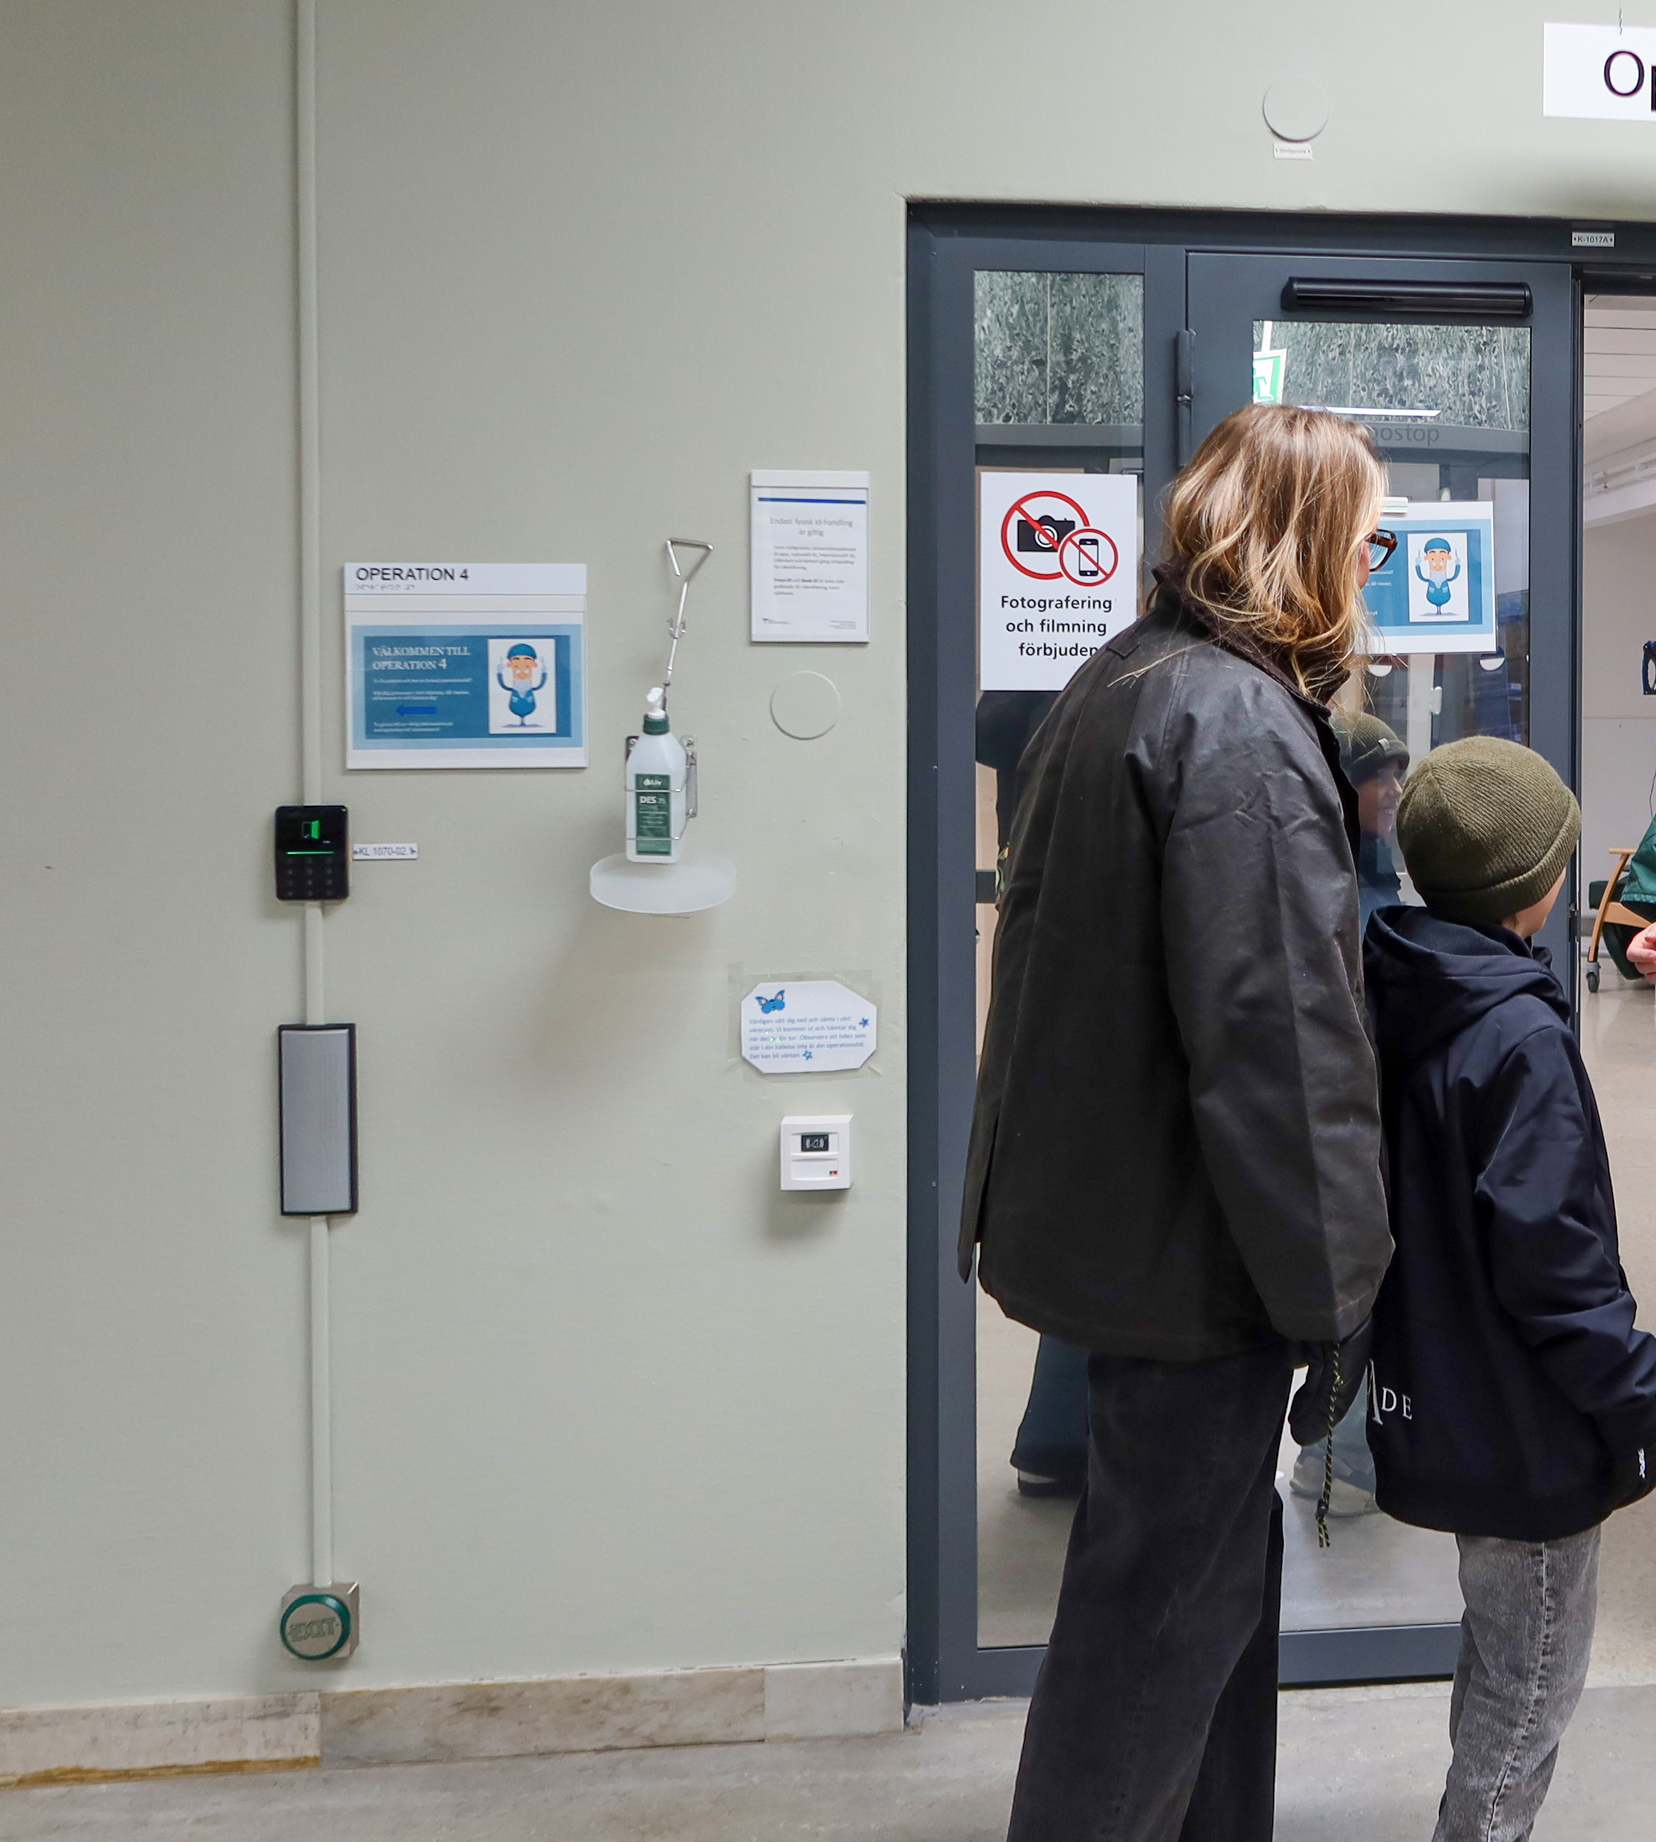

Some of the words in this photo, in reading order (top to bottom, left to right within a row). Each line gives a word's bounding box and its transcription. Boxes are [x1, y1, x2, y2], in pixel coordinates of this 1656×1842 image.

[356, 567, 455, 581] OPERATION
[459, 568, 469, 581] 4
[1001, 595, 1112, 613] Fotografering
[1006, 619, 1034, 633] och
[1039, 619, 1107, 636] filmning
[371, 646, 443, 656] VÄLKOMMEN
[446, 646, 471, 656] TILL
[372, 660, 436, 670] OPERATION
[438, 658, 447, 670] 4
[640, 795, 658, 804] DES
